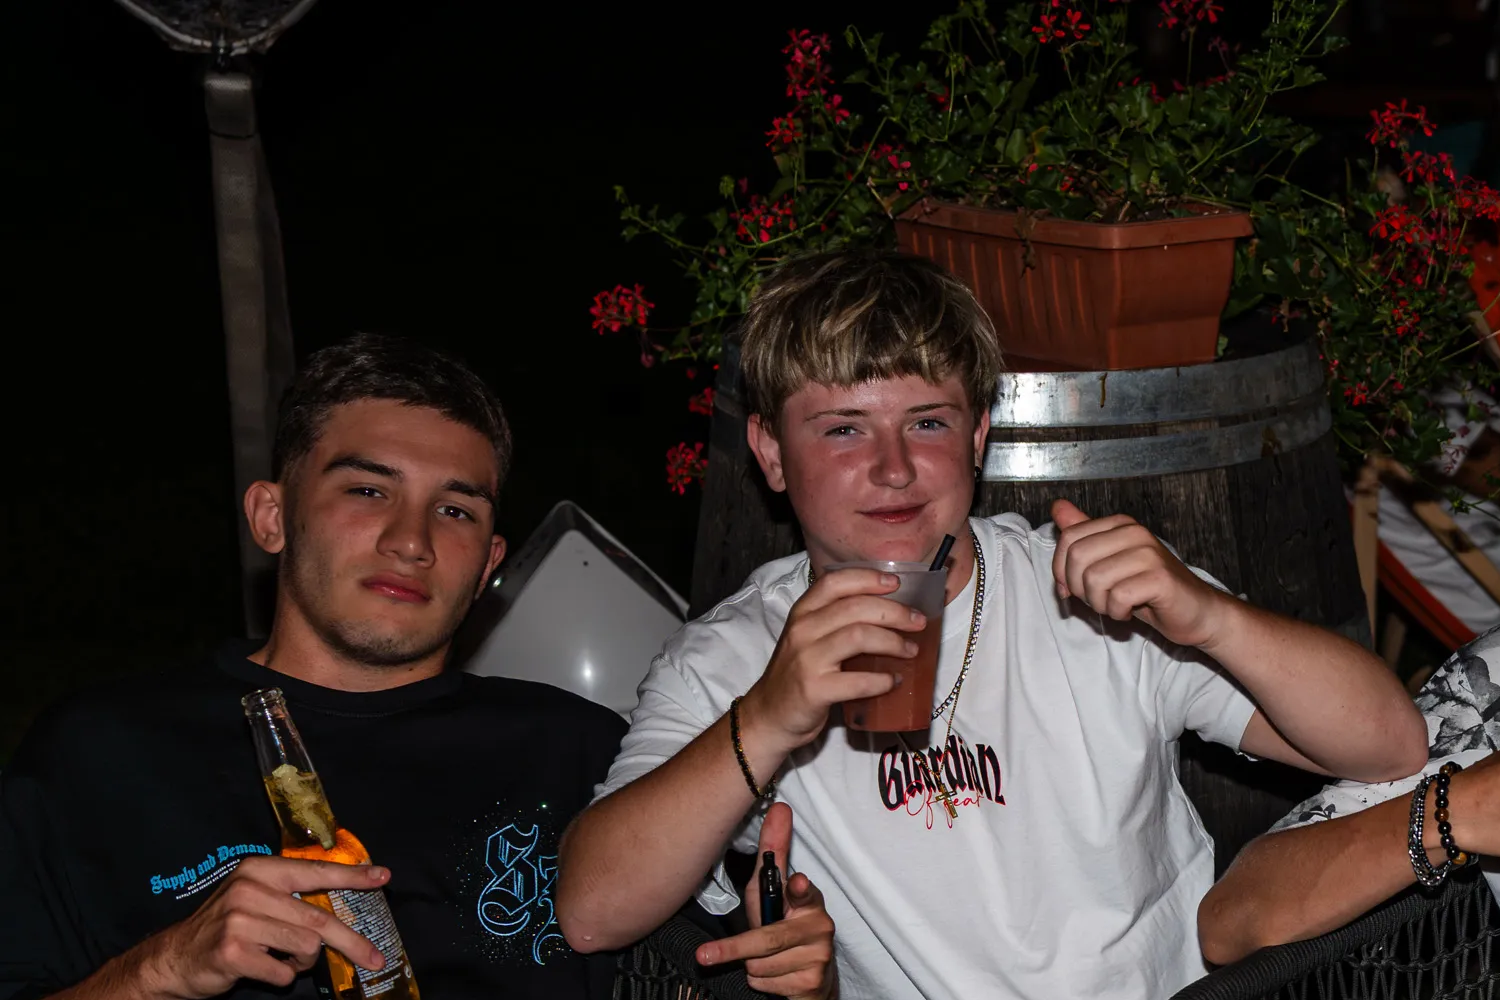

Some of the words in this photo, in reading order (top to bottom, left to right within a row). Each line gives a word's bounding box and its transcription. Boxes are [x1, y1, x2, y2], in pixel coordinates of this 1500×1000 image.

[150, 866, 197, 895] Supply
[197, 853, 216, 876] and
[217, 844, 272, 863] Demand
